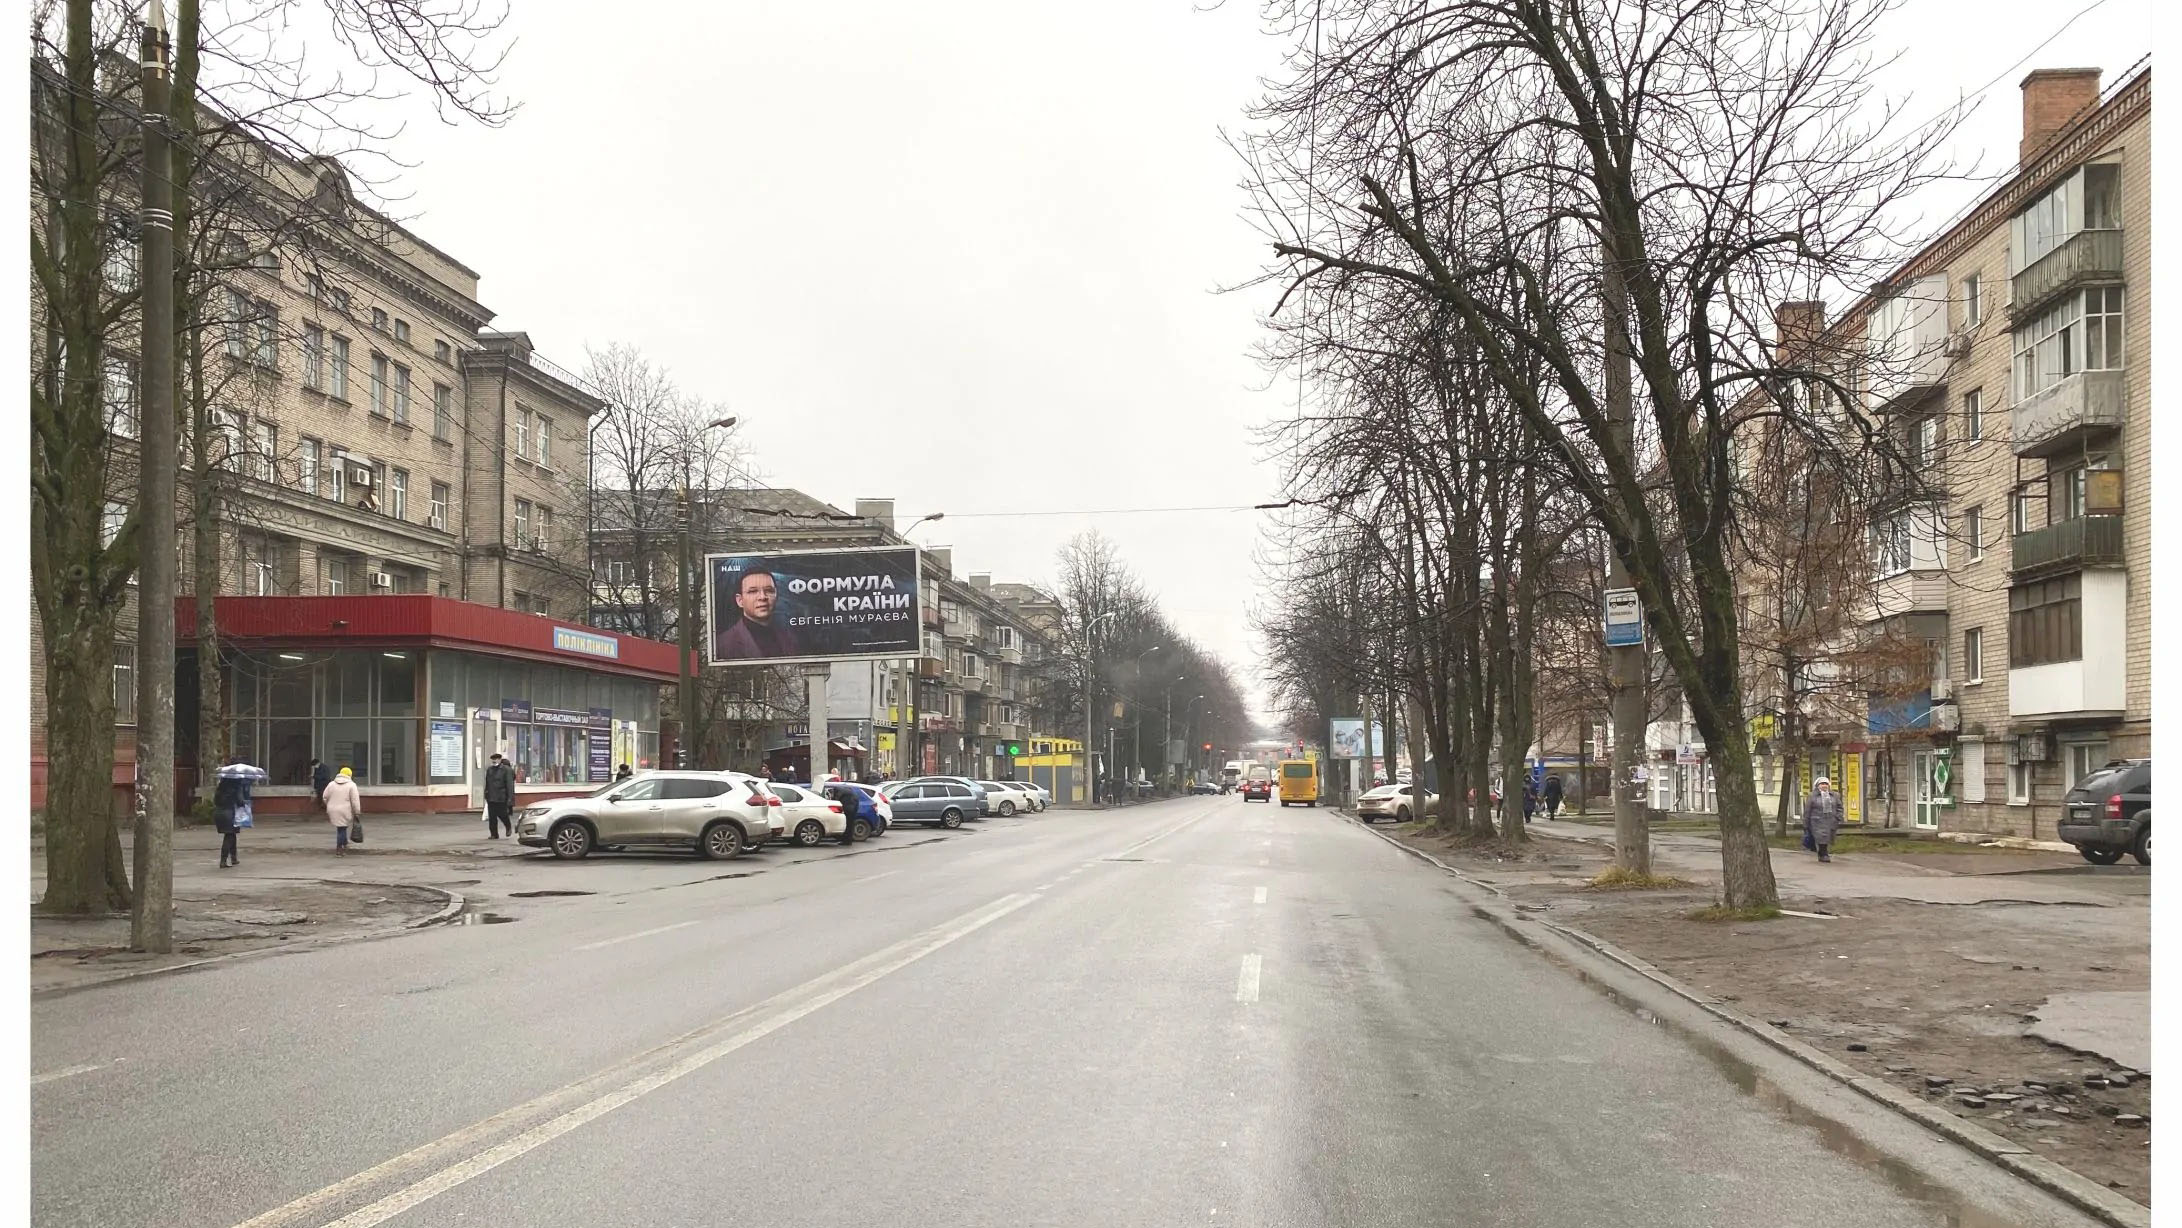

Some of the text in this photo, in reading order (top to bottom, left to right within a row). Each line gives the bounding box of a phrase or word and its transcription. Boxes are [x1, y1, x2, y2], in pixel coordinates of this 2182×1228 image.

[788, 574, 895, 594] ФОРМУЛА
[833, 591, 910, 612] КРАЇНИ
[789, 611, 909, 626] ЄВГЕНІЯ МУРАЄВА
[557, 633, 615, 656] ПОЛІКЛІНІКА
